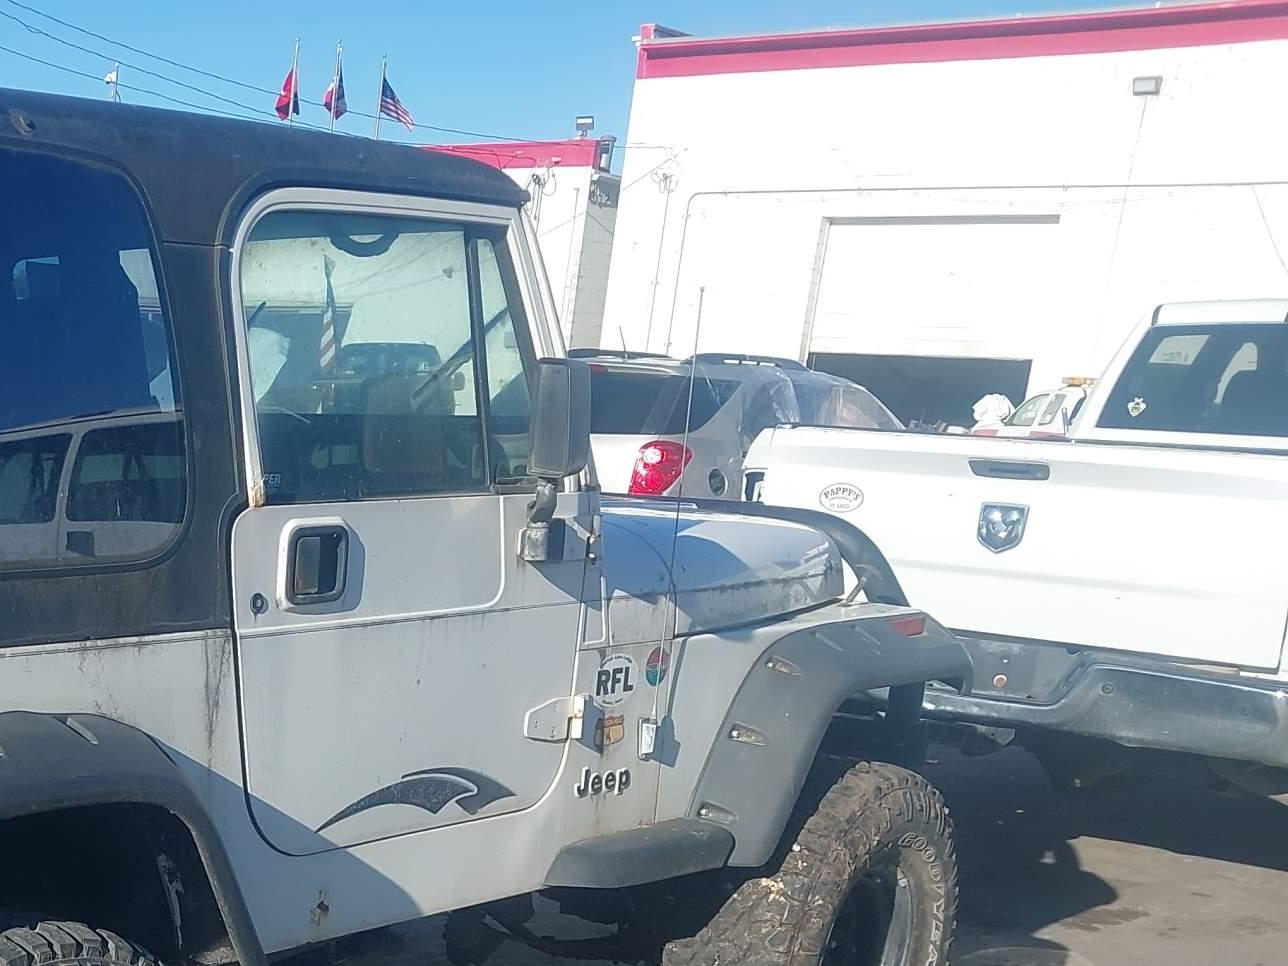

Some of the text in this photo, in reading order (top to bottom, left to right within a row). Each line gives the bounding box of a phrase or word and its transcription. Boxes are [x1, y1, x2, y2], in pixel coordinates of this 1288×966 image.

[823, 486, 860, 501] PAPPY'S
[596, 666, 634, 697] RFL
[574, 766, 631, 798] Jeep
